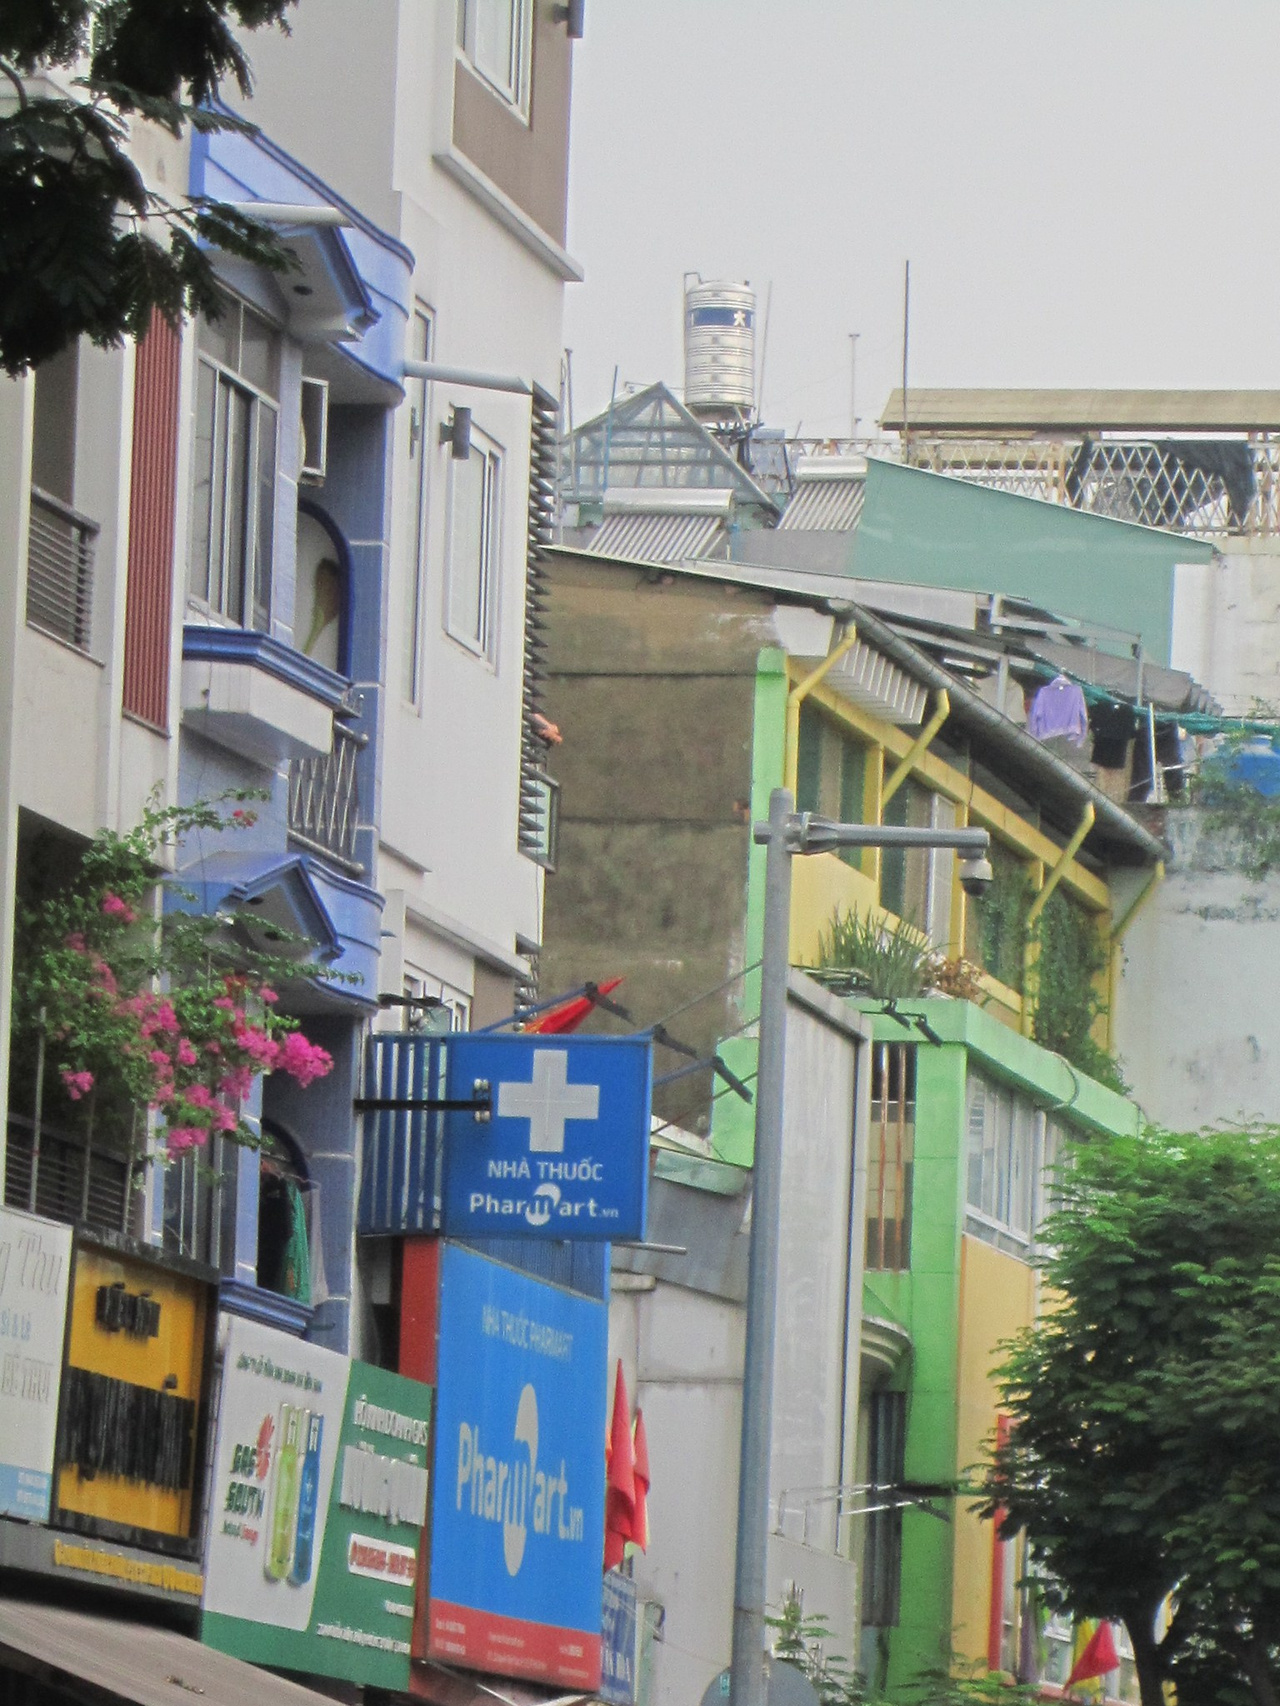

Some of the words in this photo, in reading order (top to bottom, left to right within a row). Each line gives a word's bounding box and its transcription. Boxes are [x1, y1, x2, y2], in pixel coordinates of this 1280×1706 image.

[488, 1157, 531, 1179] NHÀ
[537, 1156, 603, 1181] THUỐC
[224, 1481, 266, 1519] SOUTH
